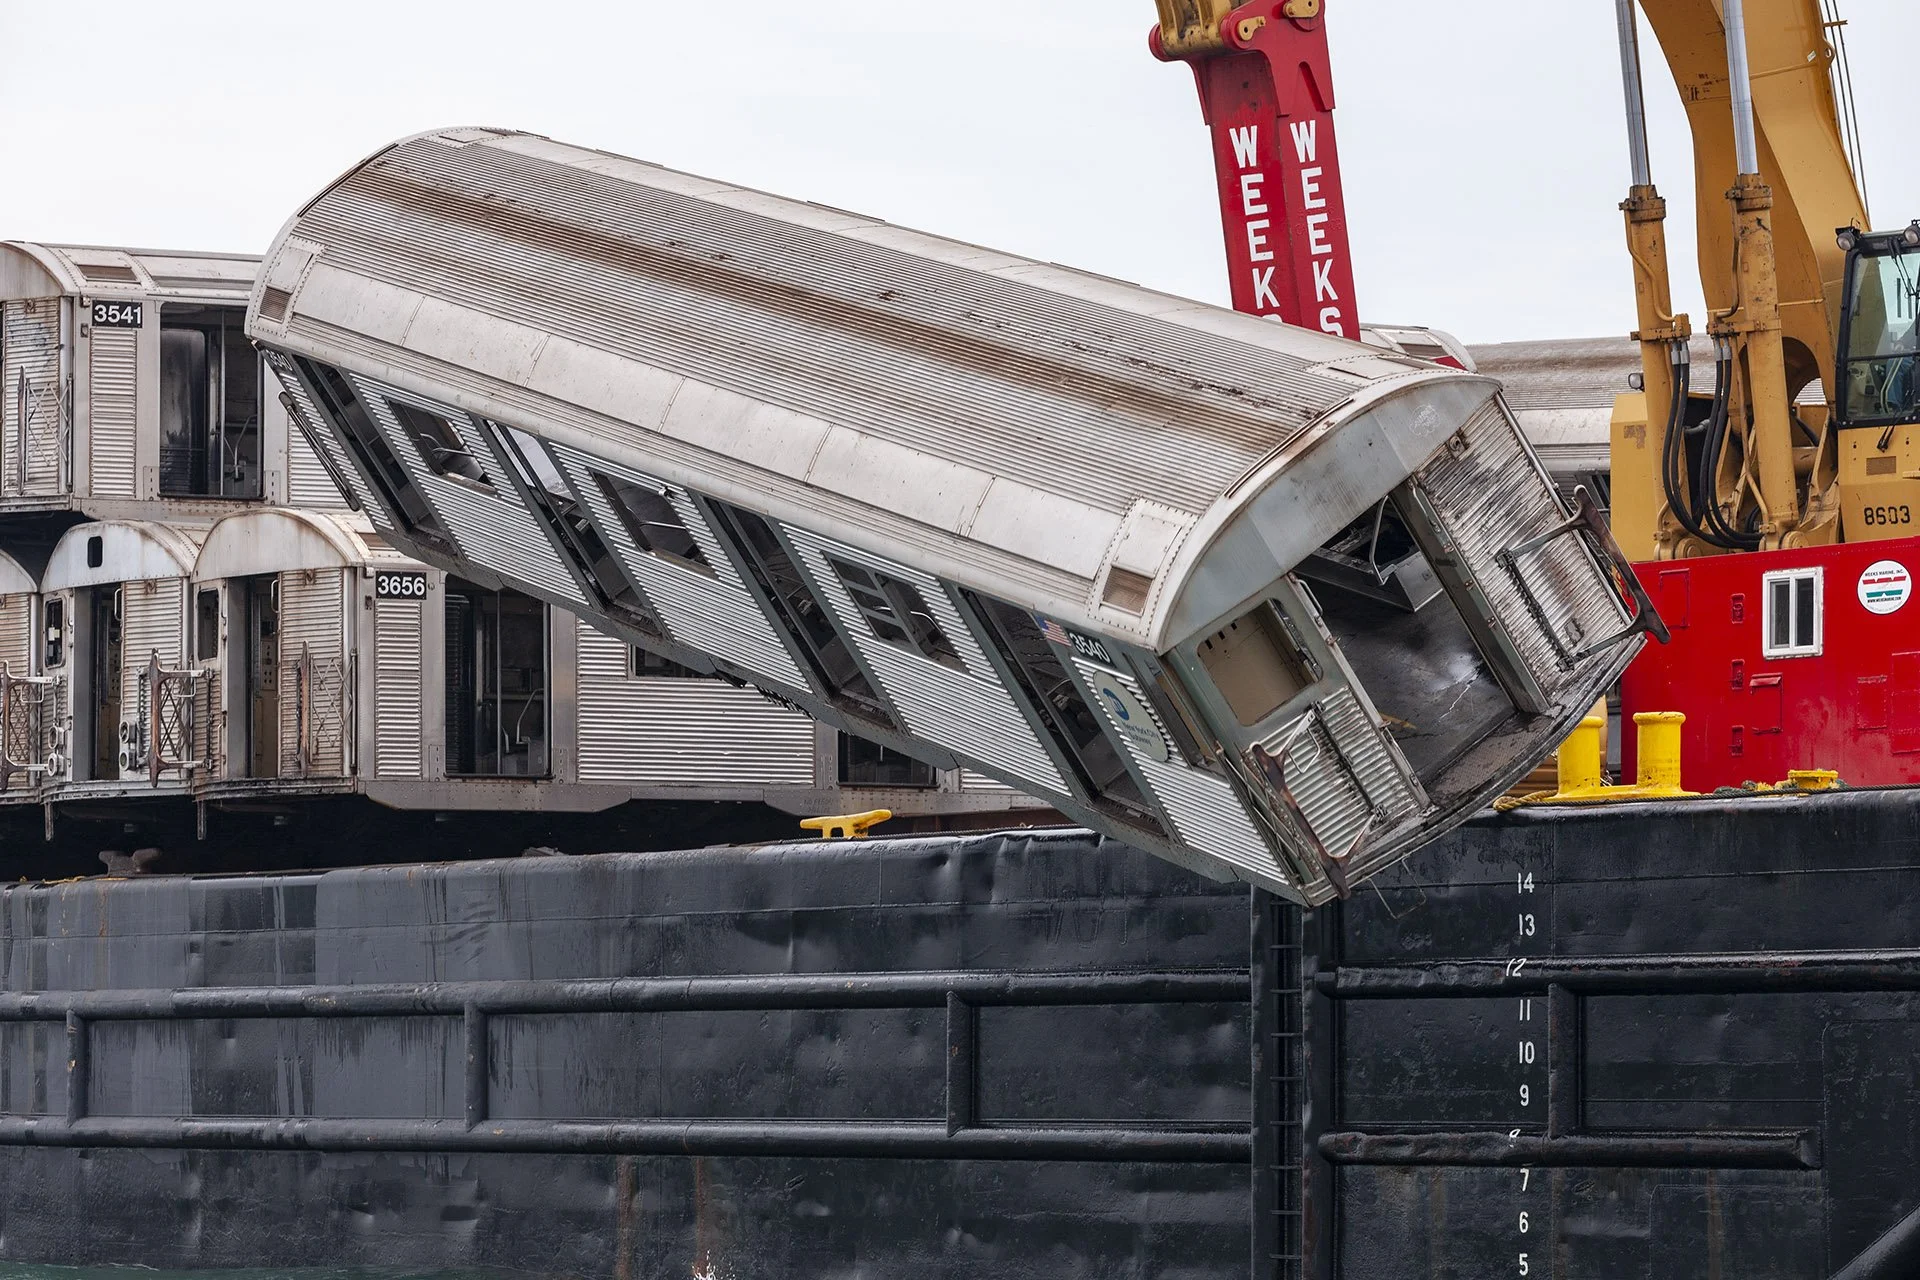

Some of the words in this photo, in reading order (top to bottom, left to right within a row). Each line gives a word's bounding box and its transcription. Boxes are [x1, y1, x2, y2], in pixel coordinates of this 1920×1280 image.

[1229, 125, 1282, 323] WEEK
[1290, 120, 1344, 337] WEEKS
[94, 304, 141, 324] 3541
[1864, 505, 1911, 525] 8603
[378, 575, 425, 596] 3656
[1069, 632, 1111, 663] 3540
[1517, 871, 1535, 894] 14
[1518, 913, 1536, 936] 13
[1506, 958, 1527, 977] 12
[1519, 999, 1531, 1021] 11
[1519, 1041, 1535, 1064] 10
[1519, 1084, 1529, 1107] 9
[1519, 1168, 1530, 1192] 7
[1519, 1211, 1529, 1233] 6
[1519, 1253, 1529, 1276] 5
